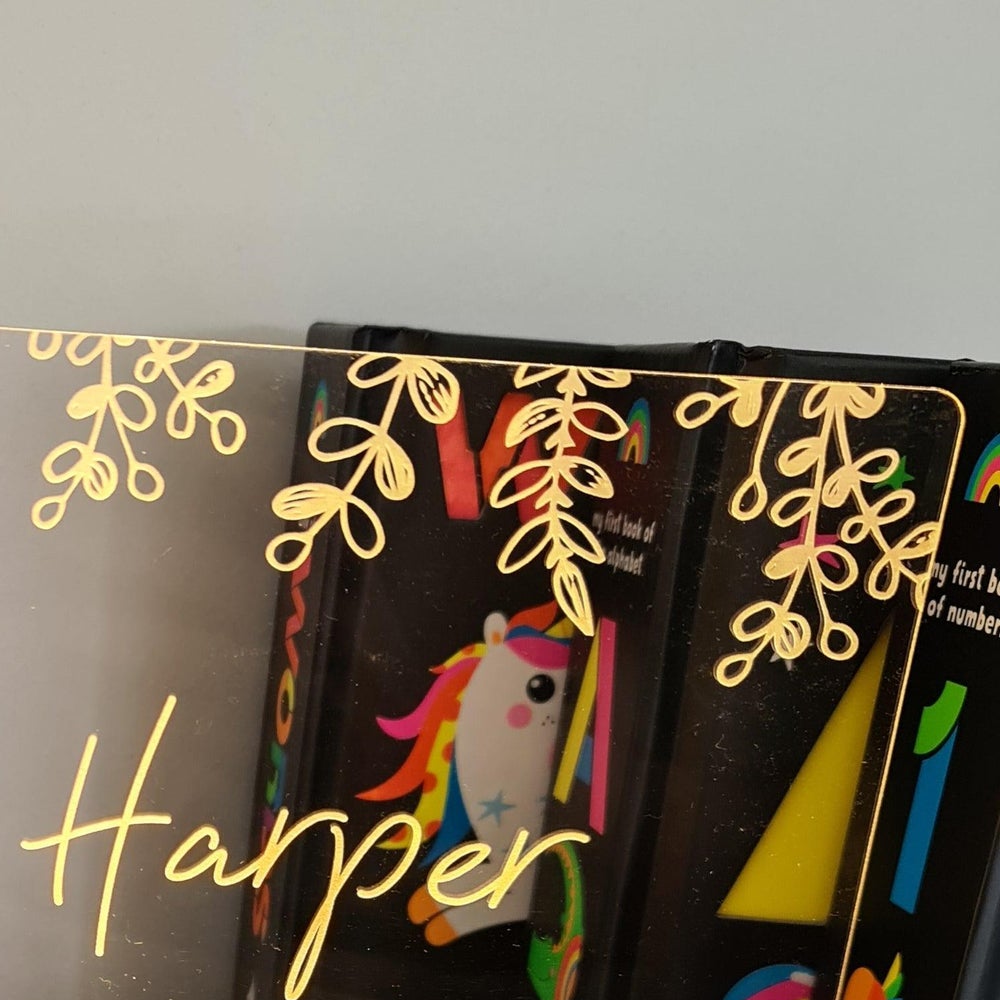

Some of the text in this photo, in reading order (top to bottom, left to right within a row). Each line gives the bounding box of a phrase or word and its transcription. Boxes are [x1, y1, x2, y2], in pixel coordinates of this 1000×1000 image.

[622, 514, 642, 541] book
[643, 521, 656, 544] of
[952, 559, 986, 591] first
[927, 594, 1000, 639] of number
